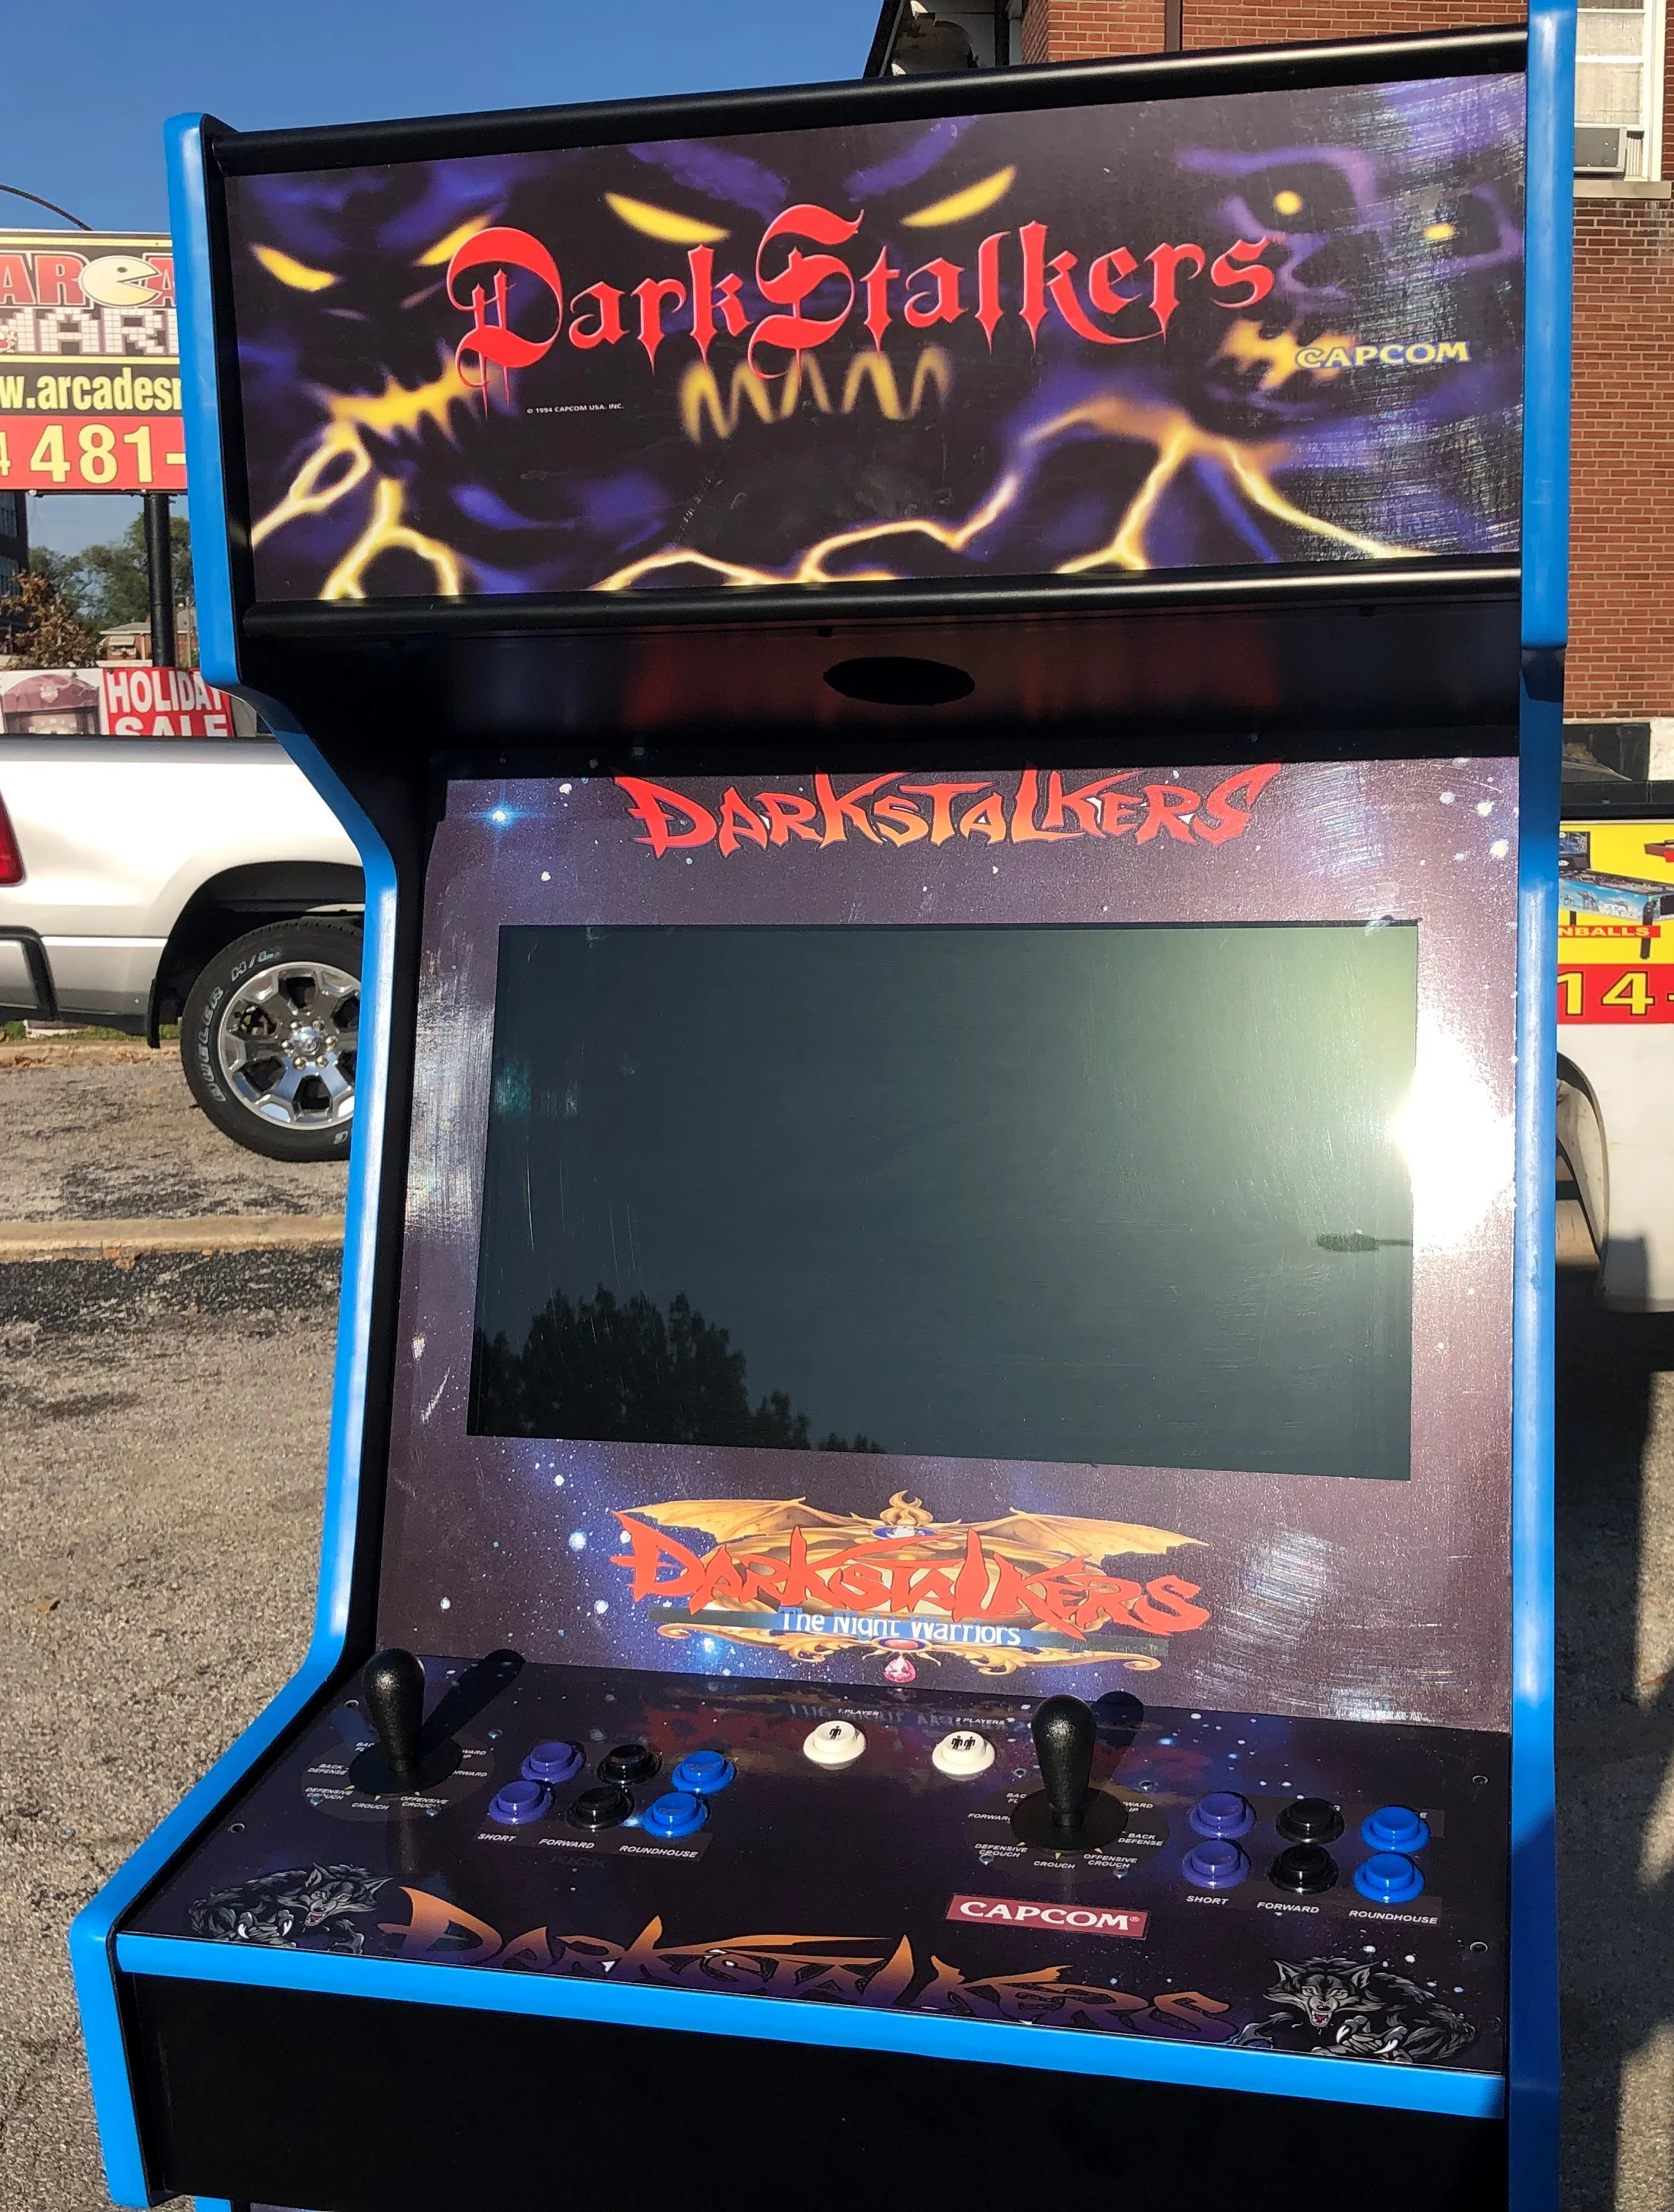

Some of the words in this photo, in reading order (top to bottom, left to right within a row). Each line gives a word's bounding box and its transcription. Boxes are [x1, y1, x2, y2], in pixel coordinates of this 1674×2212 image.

[1294, 340, 1471, 369] CAPCOM
[554, 405, 587, 413] CAPCOM
[611, 763, 1281, 859] DARKSTALKERS
[610, 1511, 1212, 1641] DARKSTALKERS
[782, 1611, 825, 1632] The
[833, 1614, 901, 1639] Night
[910, 1618, 1022, 1646] Warriors
[844, 1708, 881, 1717] PLAYER
[962, 1717, 1006, 1726] PLAYERS
[307, 1767, 348, 1775] DEFENSE
[304, 1787, 355, 1797] DEFENSIVE
[400, 1796, 449, 1805] OFFENSIVE
[351, 1802, 390, 1810] CROUCH
[477, 1832, 517, 1843] SHORT
[1128, 1832, 1156, 1840] BACK
[539, 1837, 595, 1849] FORWARD
[1117, 1837, 1164, 1846] DEFENSE
[619, 1844, 699, 1859] ROUNDHOUSE
[974, 1843, 1029, 1853] DEFENSIVE
[979, 1849, 1021, 1859] CROUCH
[1083, 1854, 1138, 1864] OFFENSIVE
[1033, 1860, 1076, 1870] CROUCH
[1087, 1859, 1131, 1869] CROUCH
[1186, 1895, 1229, 1906] SHORT
[1257, 1901, 1320, 1914] FORWARD
[1349, 1909, 1439, 1925] ROUNDHOUSE
